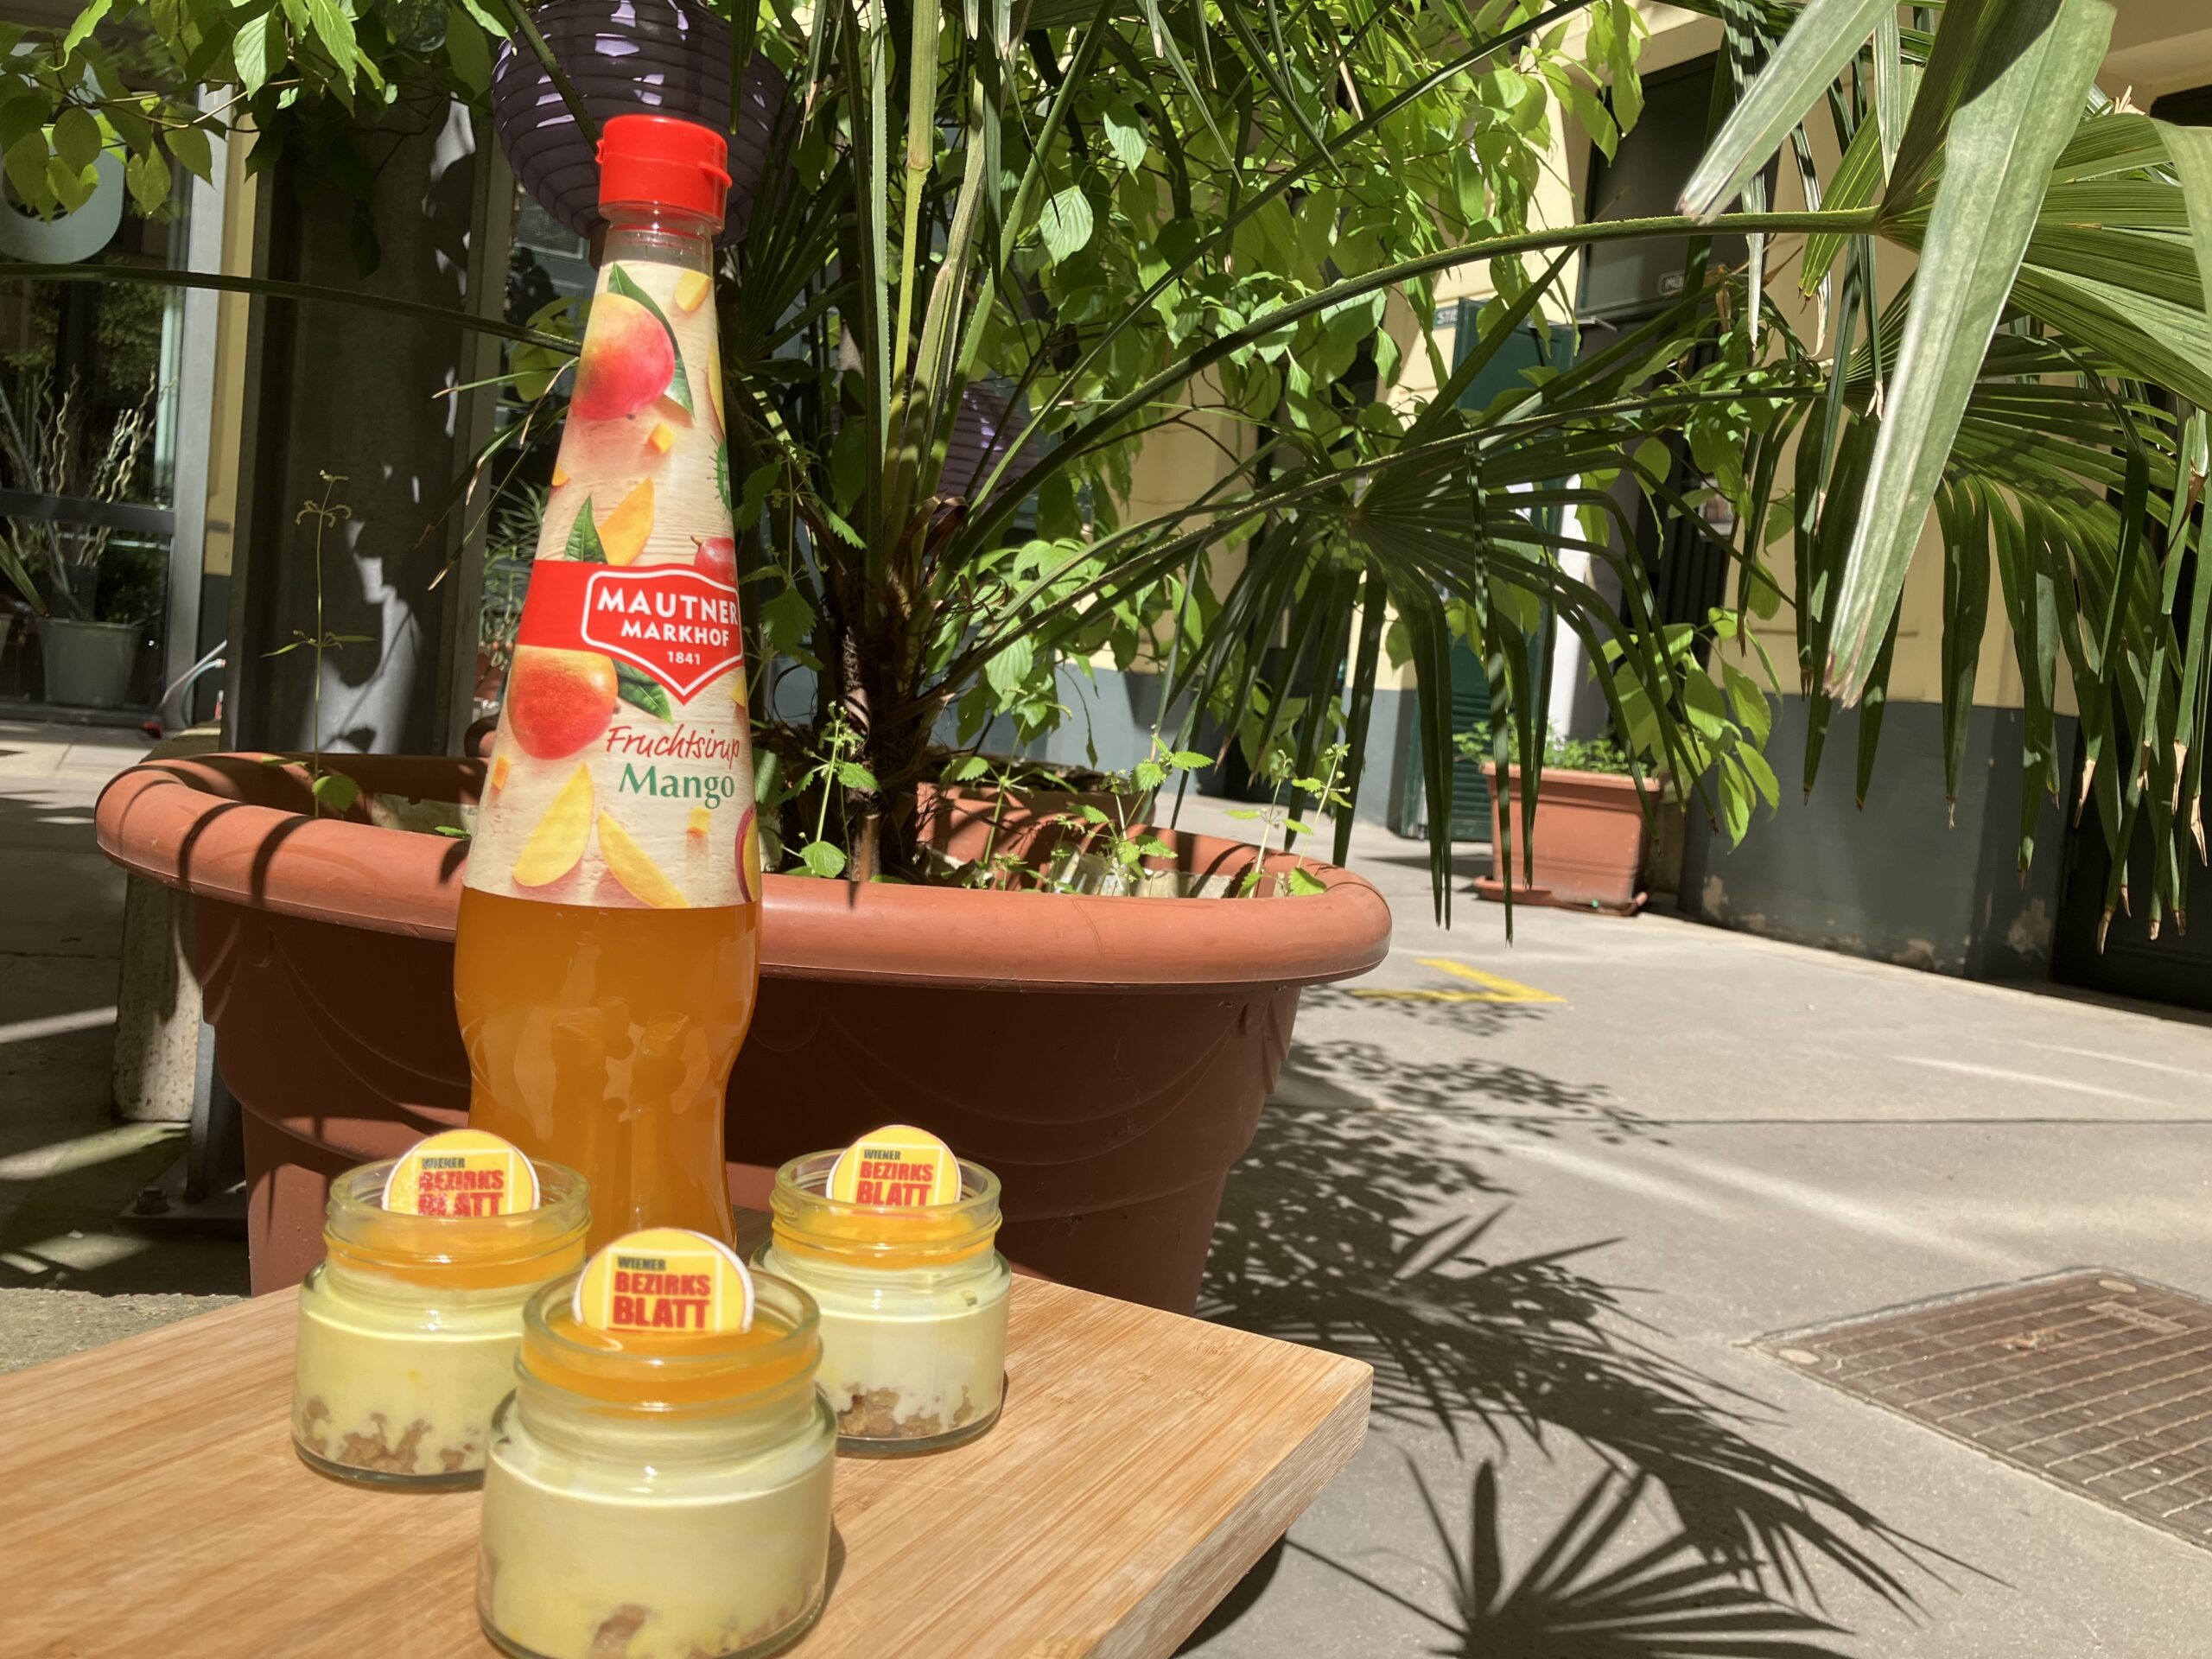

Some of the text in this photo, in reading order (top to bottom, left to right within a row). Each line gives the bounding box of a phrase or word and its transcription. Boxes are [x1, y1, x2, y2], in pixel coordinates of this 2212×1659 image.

[597, 586, 739, 626] MAUTNER
[620, 619, 729, 647] MARKHOF
[667, 651, 701, 665] 1841
[606, 723, 740, 770] Fruchtsirup
[619, 762, 735, 810] Mango
[422, 1157, 465, 1169] WIENER
[863, 1148, 901, 1160] WIENER
[419, 1169, 505, 1192] BEZIRKS
[859, 1160, 934, 1182] BEZIRKS
[417, 1192, 504, 1217] BLATT
[855, 1180, 932, 1206] BLATT
[617, 1255, 666, 1271] WIENER
[613, 1271, 711, 1296] BEZIRKS
[612, 1294, 710, 1329] BLATT
